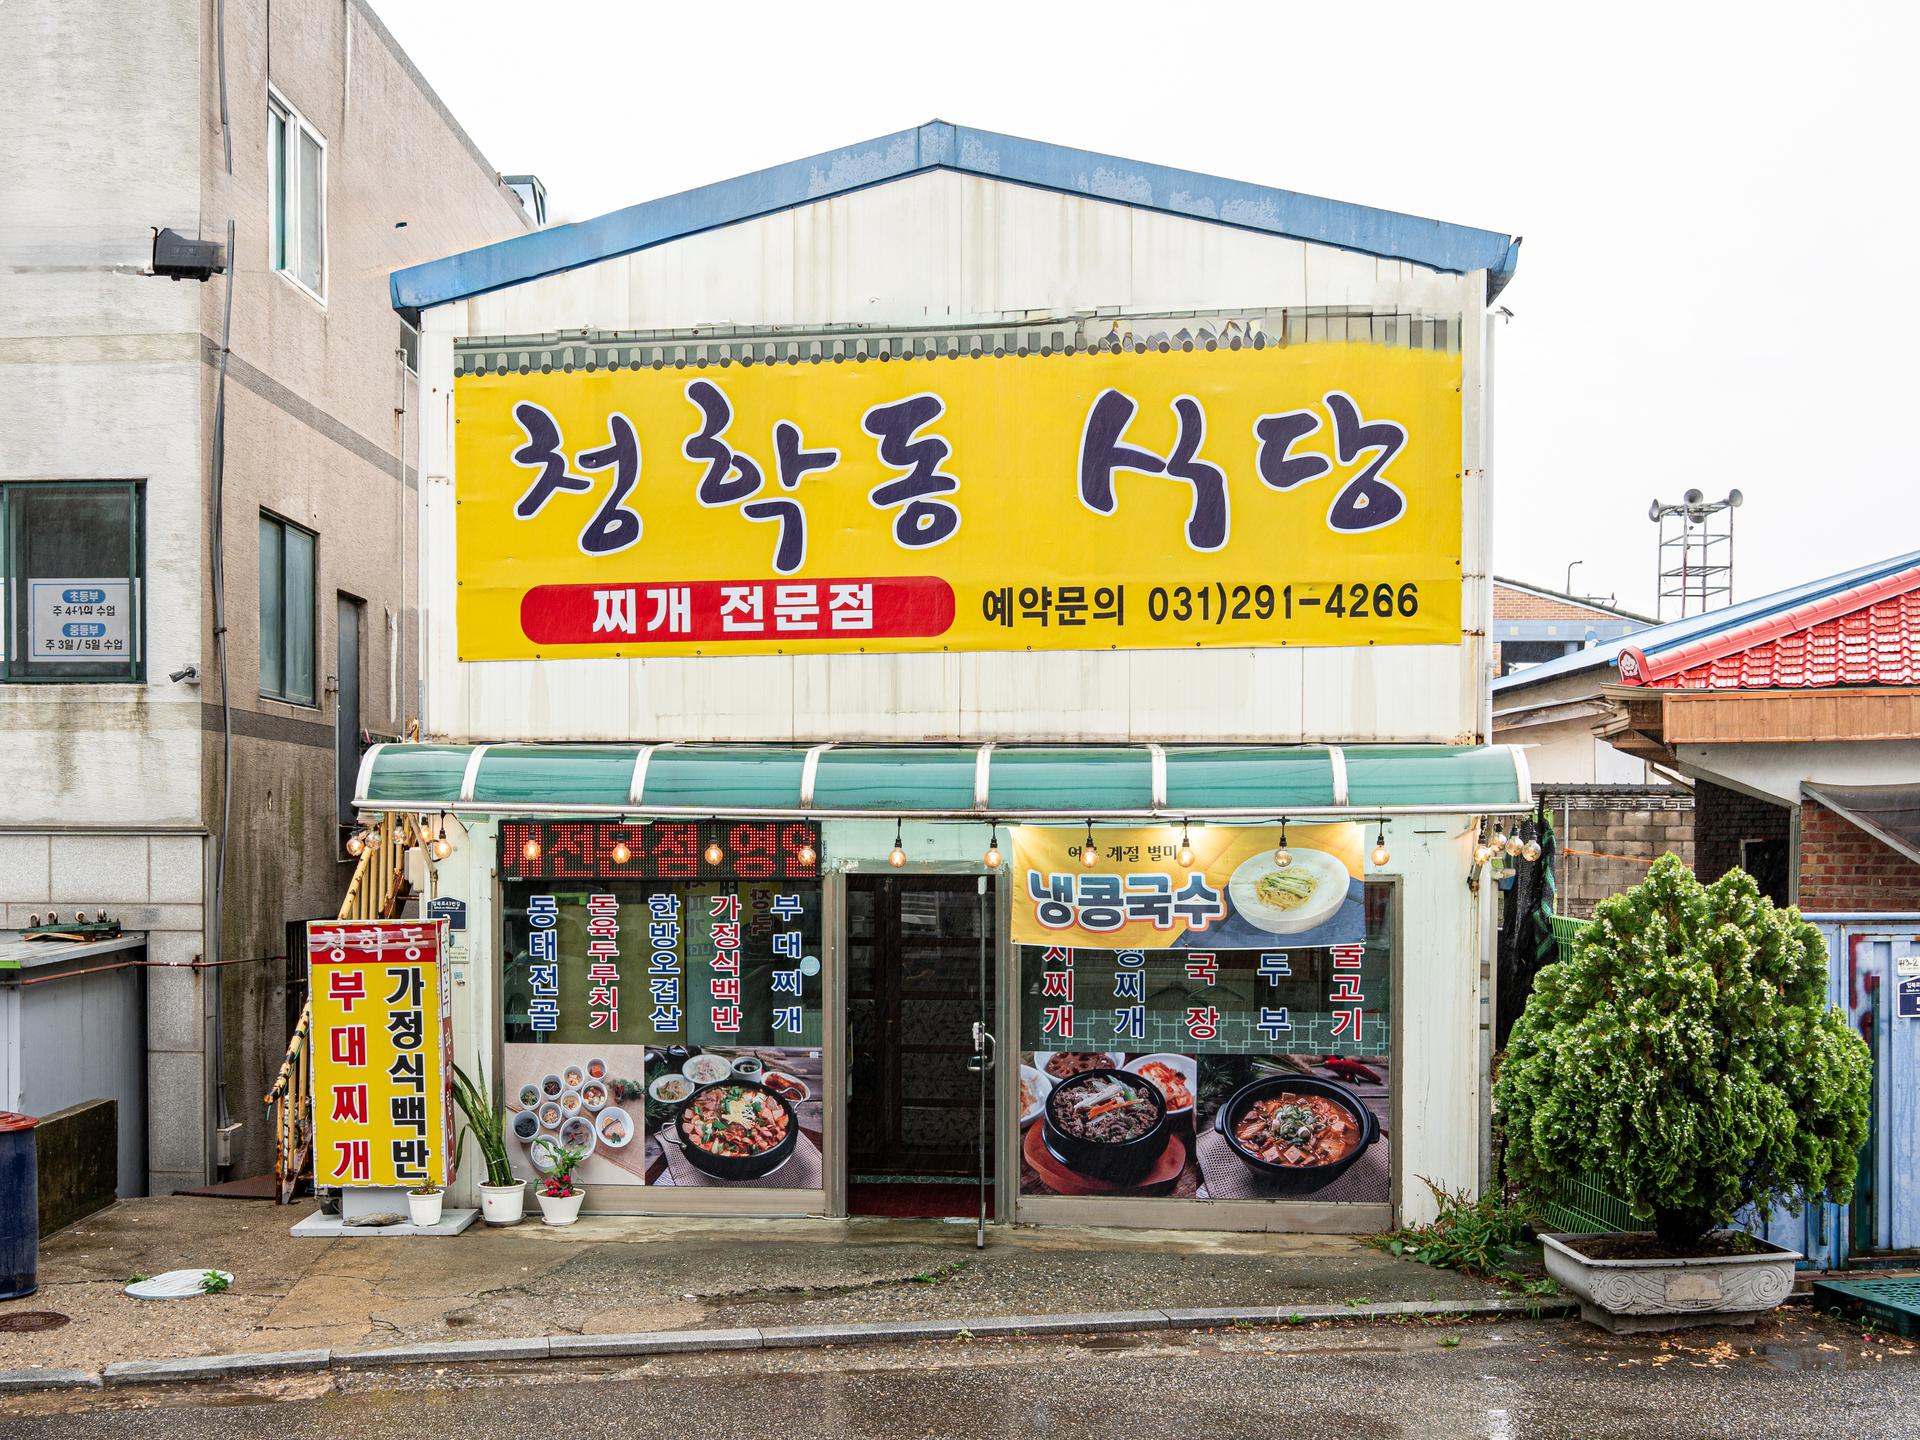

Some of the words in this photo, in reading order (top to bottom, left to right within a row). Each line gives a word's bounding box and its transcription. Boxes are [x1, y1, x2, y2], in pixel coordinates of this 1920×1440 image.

[511, 378, 960, 575] 청학동
[1078, 388, 1408, 552] 식당
[53, 606, 62, 616] 주
[96, 606, 115, 616] 수업
[70, 590, 99, 602] 초등부
[70, 624, 99, 636] 중등부
[592, 586, 692, 635] 찌개
[720, 583, 874, 632] 전문점
[983, 585, 1125, 628] 예약문의
[1148, 581, 1419, 624] 031)291-4266
[46, 640, 55, 650] 주
[58, 640, 73, 650] 3일
[85, 640, 100, 650] 5일
[104, 640, 122, 650] 수업
[1107, 846, 1139, 862] 계절
[1148, 845, 1178, 862] 별미
[1027, 869, 1225, 931] 냉콩국수
[311, 927, 429, 962] 청학동
[527, 895, 559, 1032] 동태전골
[587, 894, 619, 1033] 돈육두루치기
[648, 894, 681, 1033] 한방오겹살
[709, 894, 743, 1033] 가정식백반
[770, 894, 803, 1033] 부대찌개
[1184, 953, 1220, 1040] 국장
[1256, 953, 1292, 1041] 두부
[1329, 944, 1366, 1041] 불고기
[328, 970, 371, 1180] 부대찌개
[384, 966, 430, 1180] 가정식백반
